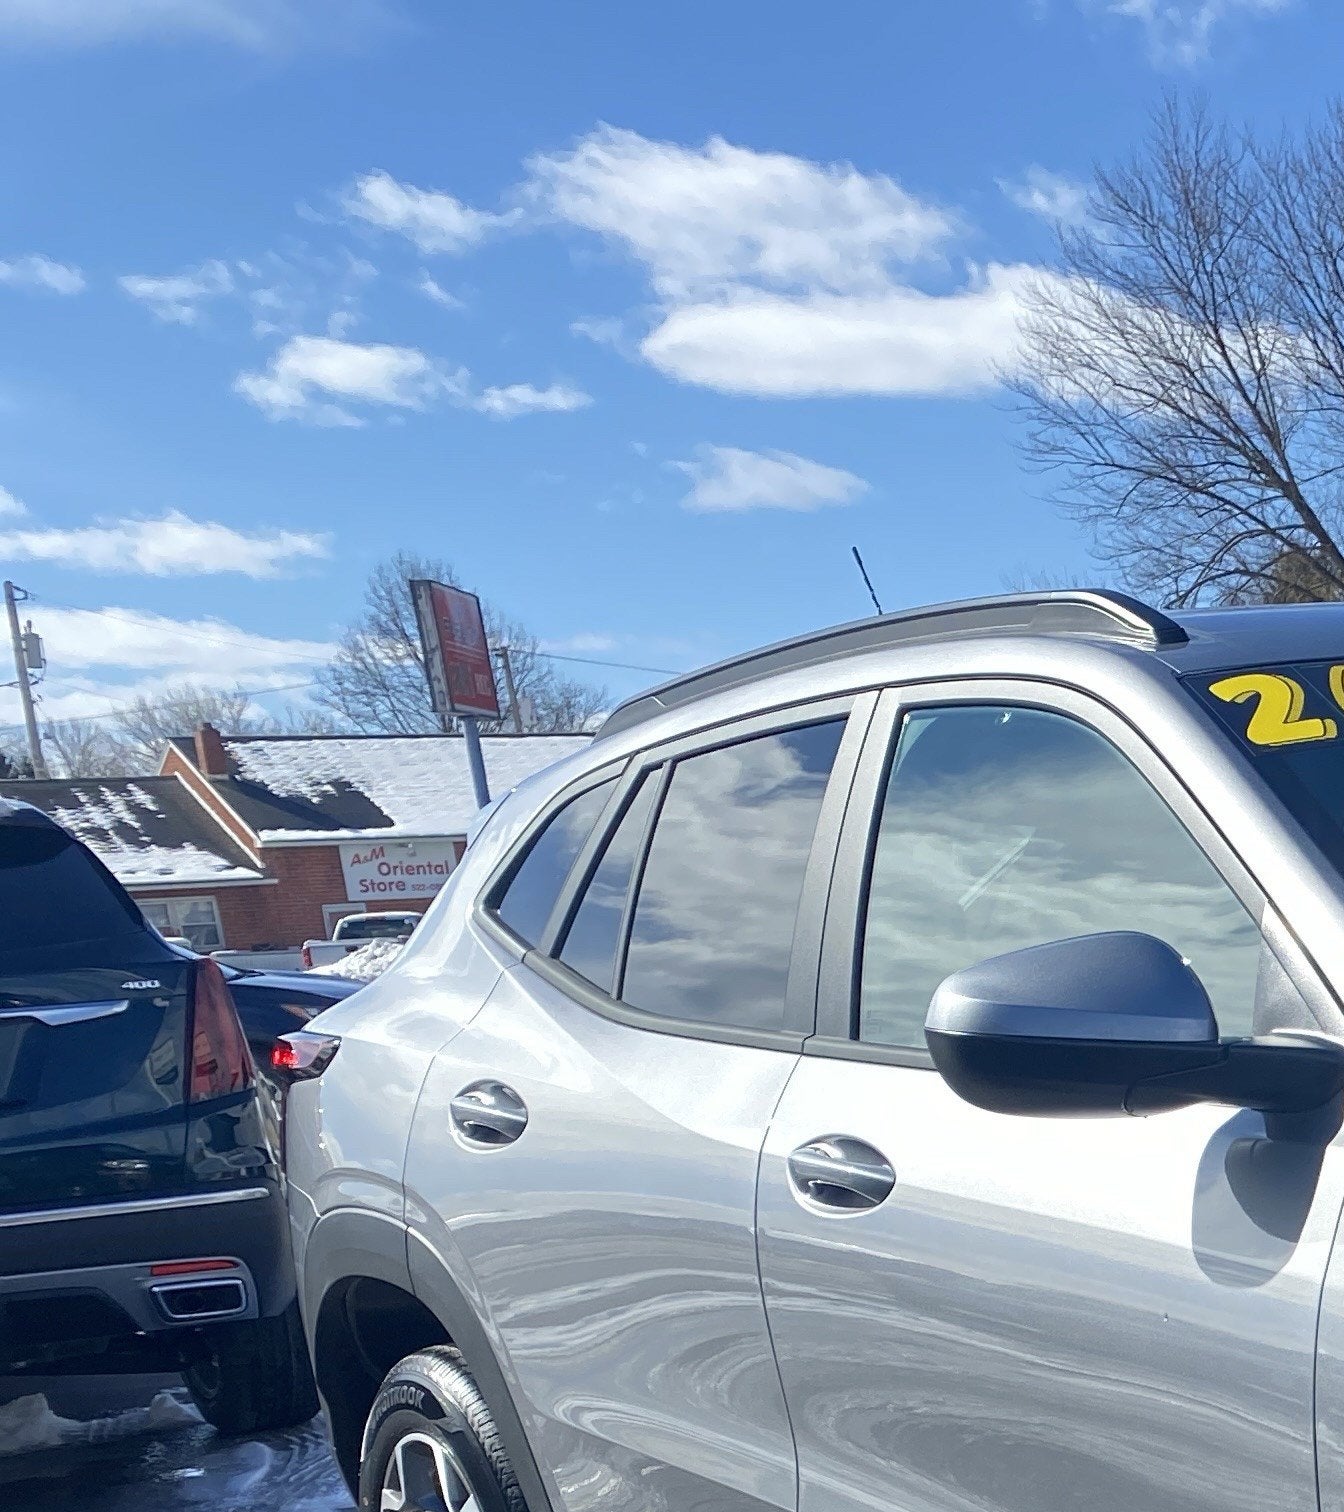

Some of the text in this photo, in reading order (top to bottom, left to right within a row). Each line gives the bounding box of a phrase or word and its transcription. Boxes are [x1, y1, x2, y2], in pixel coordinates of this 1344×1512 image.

[350, 846, 386, 867] A&M
[378, 860, 449, 876] Oriental
[360, 879, 406, 893] Store
[121, 979, 161, 989] 400
